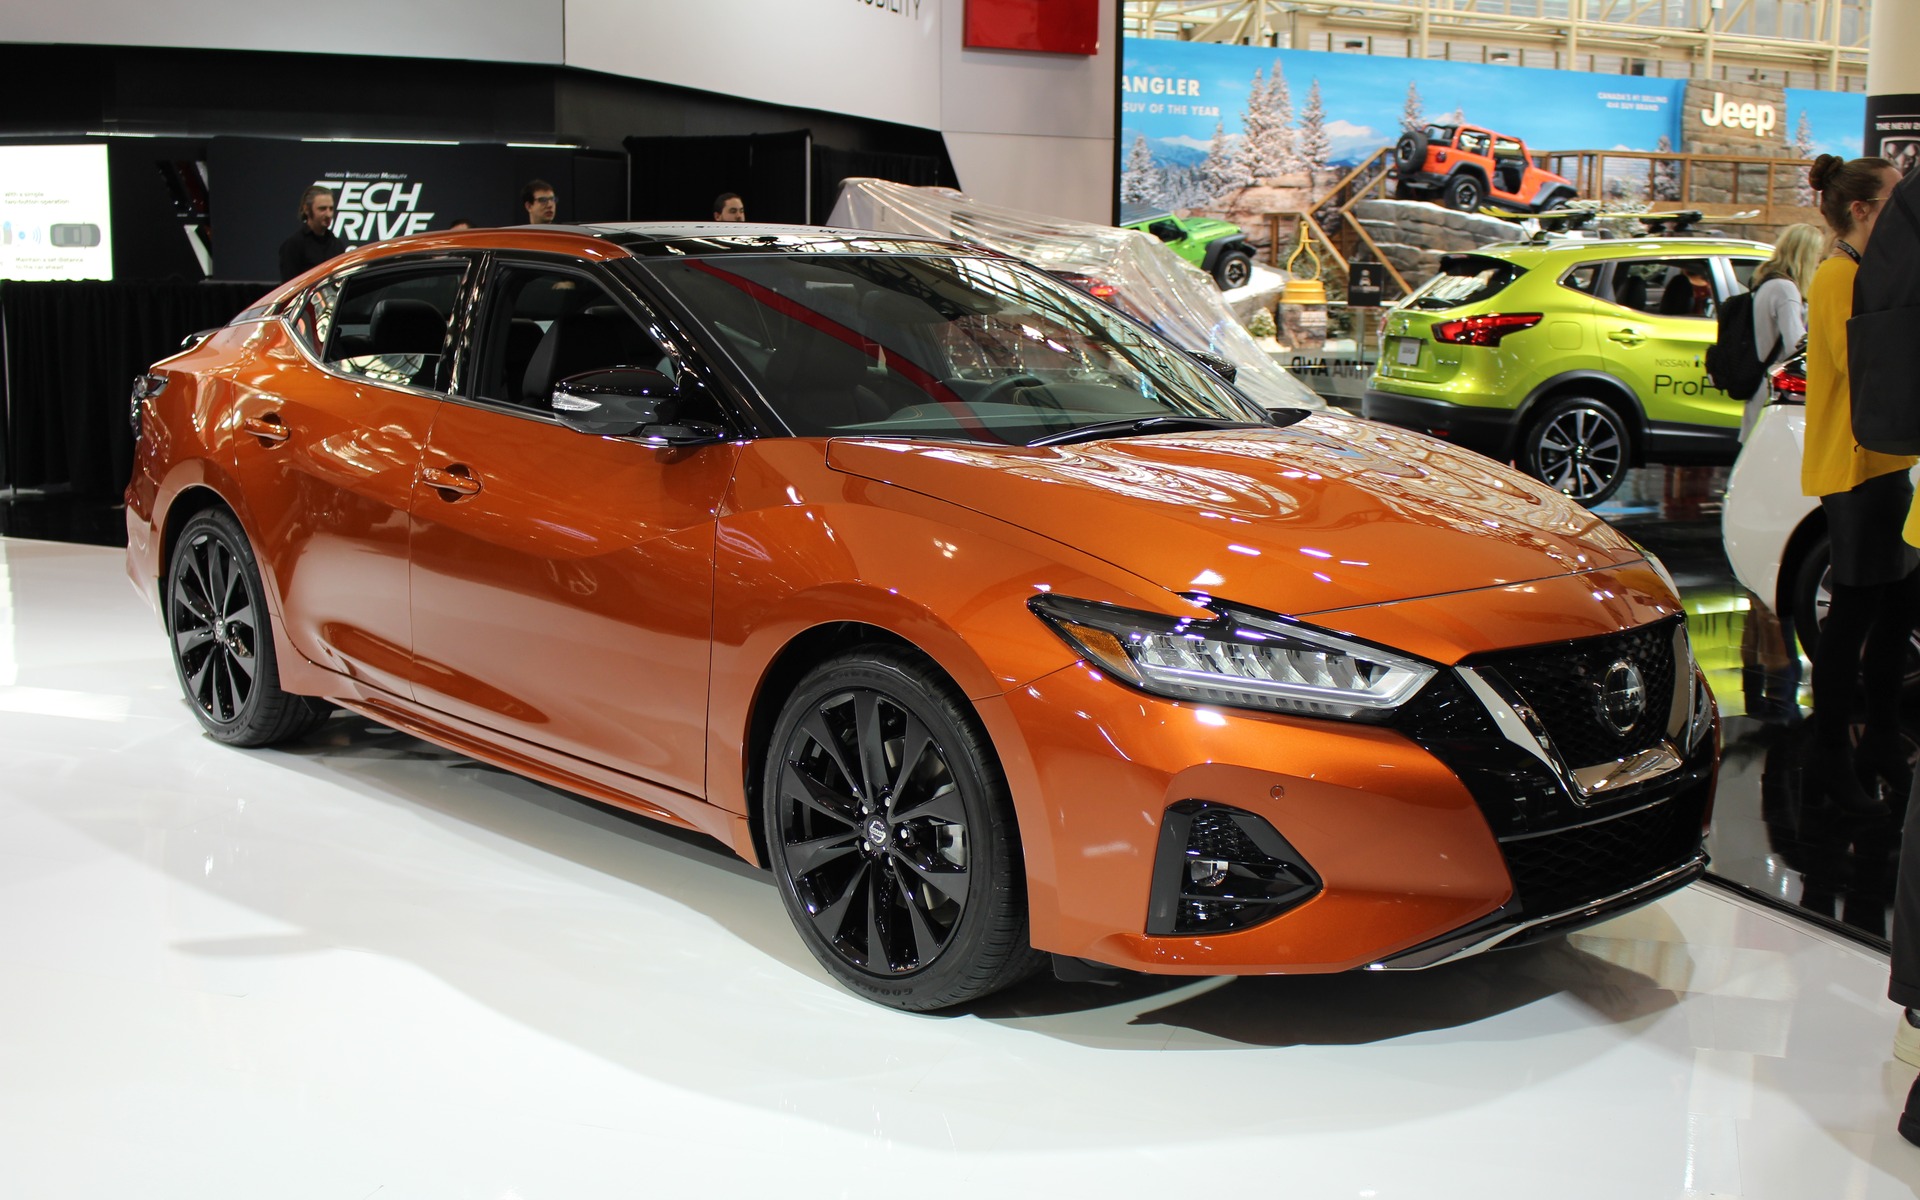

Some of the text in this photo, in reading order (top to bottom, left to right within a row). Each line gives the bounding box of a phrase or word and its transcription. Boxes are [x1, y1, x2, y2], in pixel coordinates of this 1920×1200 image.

[1123, 101, 1219, 117] SUV OF THE YEAR
[1701, 92, 1776, 137] Jeep
[326, 211, 435, 241] RIVE
